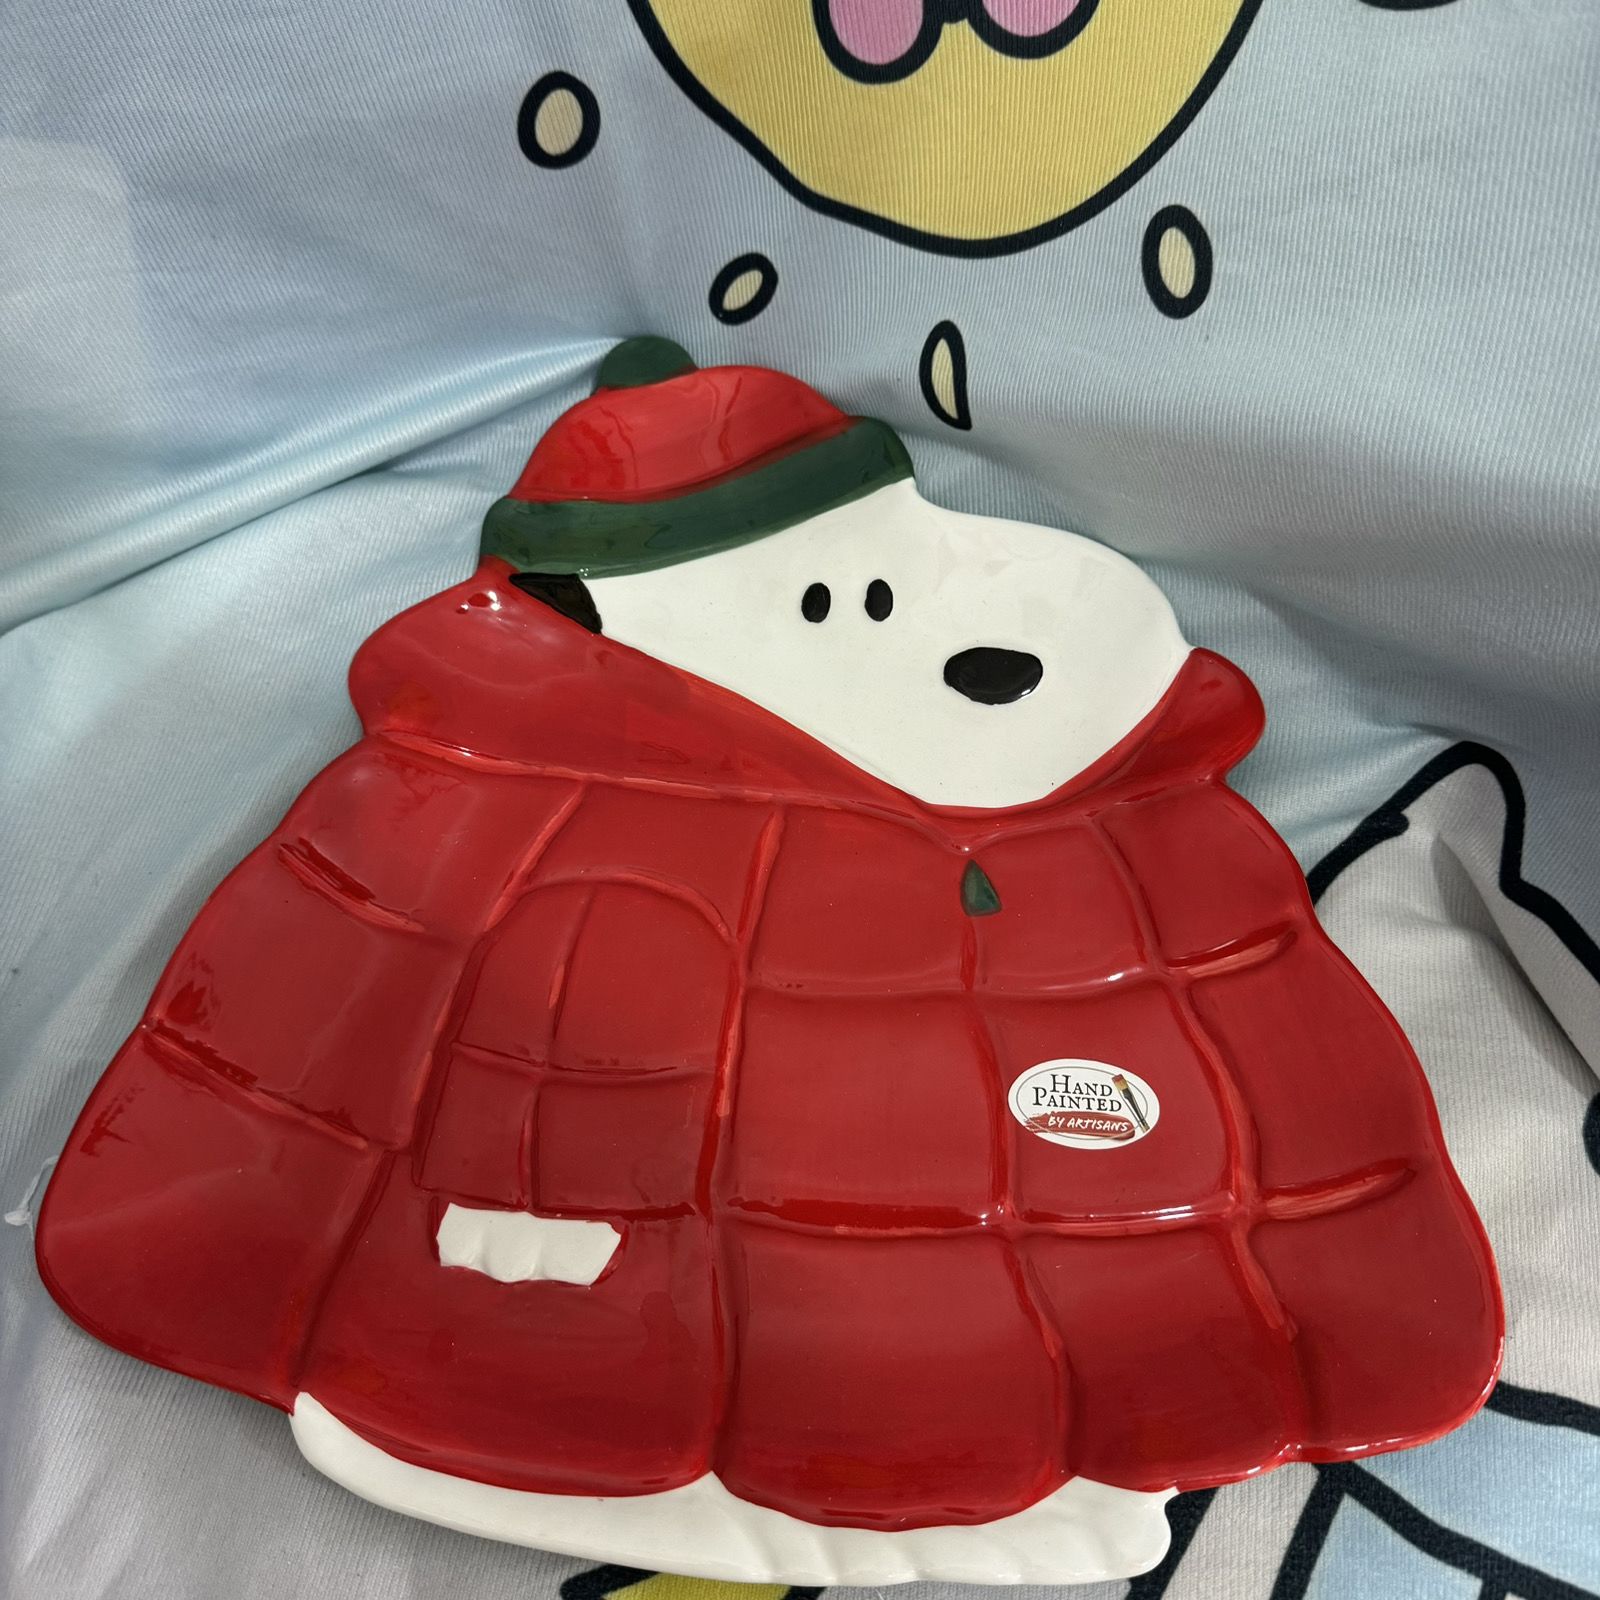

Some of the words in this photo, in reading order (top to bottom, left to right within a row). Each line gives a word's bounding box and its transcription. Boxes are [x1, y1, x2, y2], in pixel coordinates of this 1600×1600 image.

[1050, 1074, 1113, 1097] HAND
[1032, 1087, 1122, 1112] PAINTED
[1048, 1116, 1065, 1128] BY
[1067, 1118, 1129, 1132] ARTISANS
